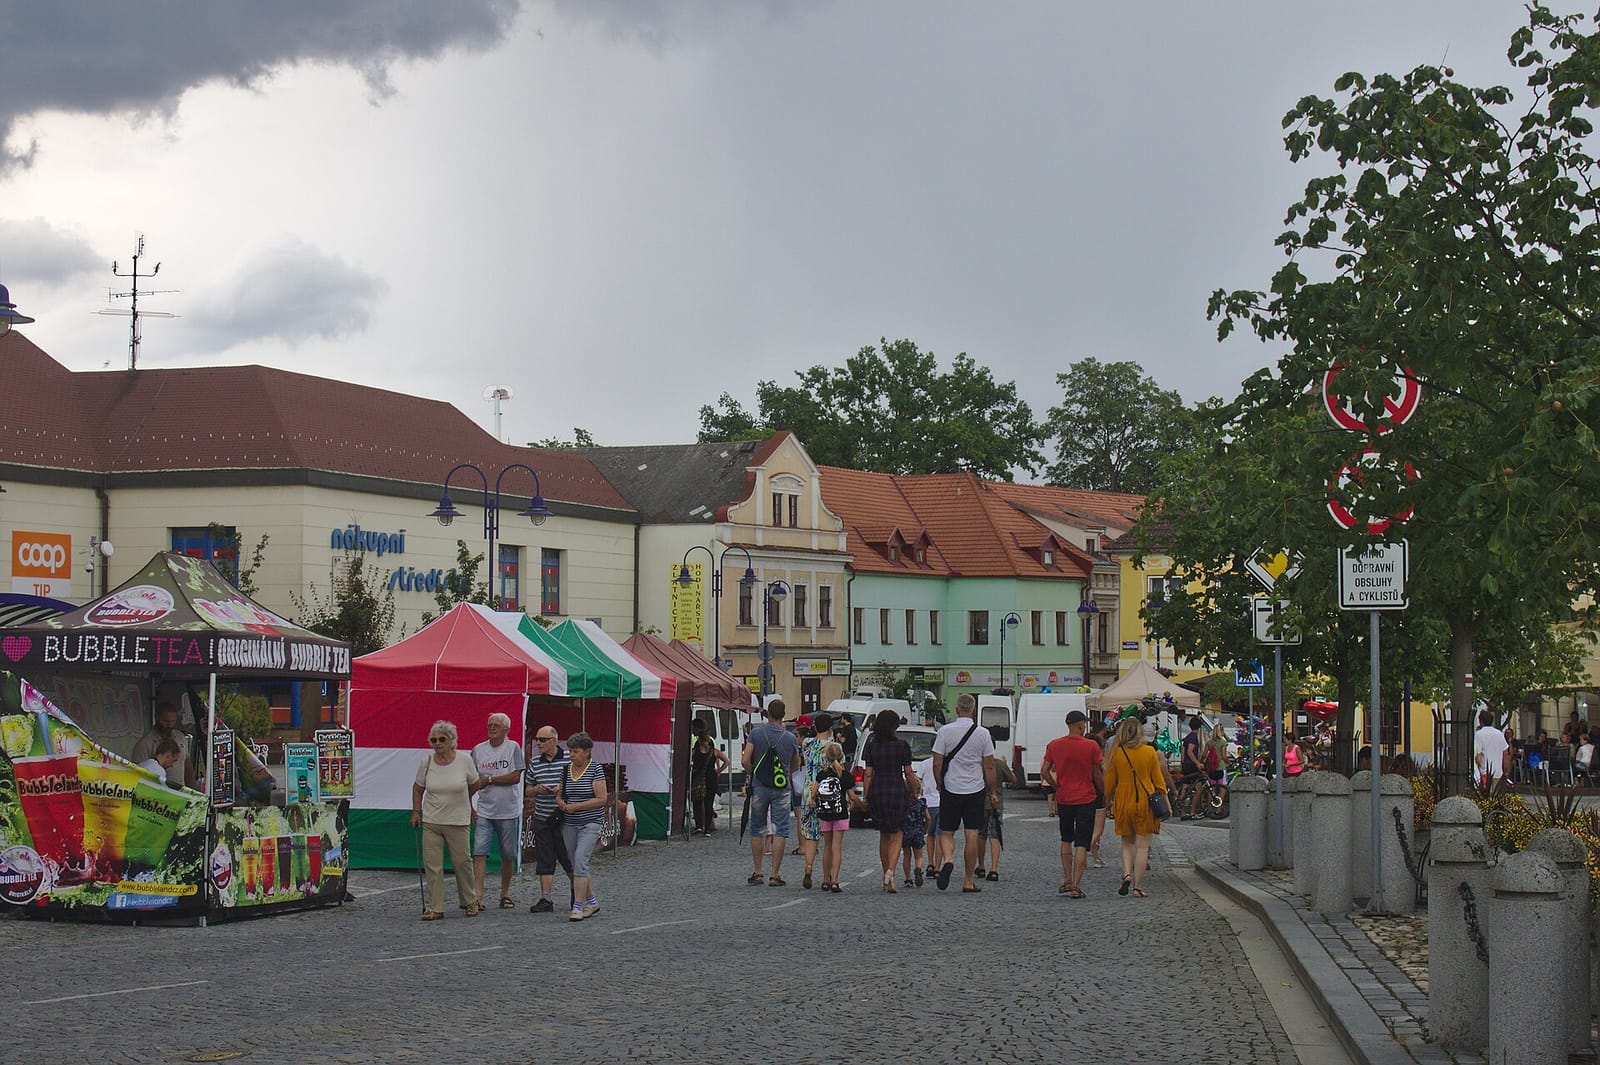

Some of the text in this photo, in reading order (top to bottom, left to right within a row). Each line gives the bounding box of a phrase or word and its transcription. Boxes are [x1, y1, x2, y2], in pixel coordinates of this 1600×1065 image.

[18, 542, 65, 574] coop
[1352, 560, 1394, 573] DOPRAVNÍ
[1355, 577, 1392, 587] OBSLUHY
[33, 583, 51, 597] TIP
[1349, 589, 1398, 601] A CYKLISTŮ
[217, 635, 350, 674] ORIGINÁLNÍ BUBBLE TEA
[0, 874, 27, 884] BUBBLE
[121, 883, 195, 894] www.bubblelandcz.com
